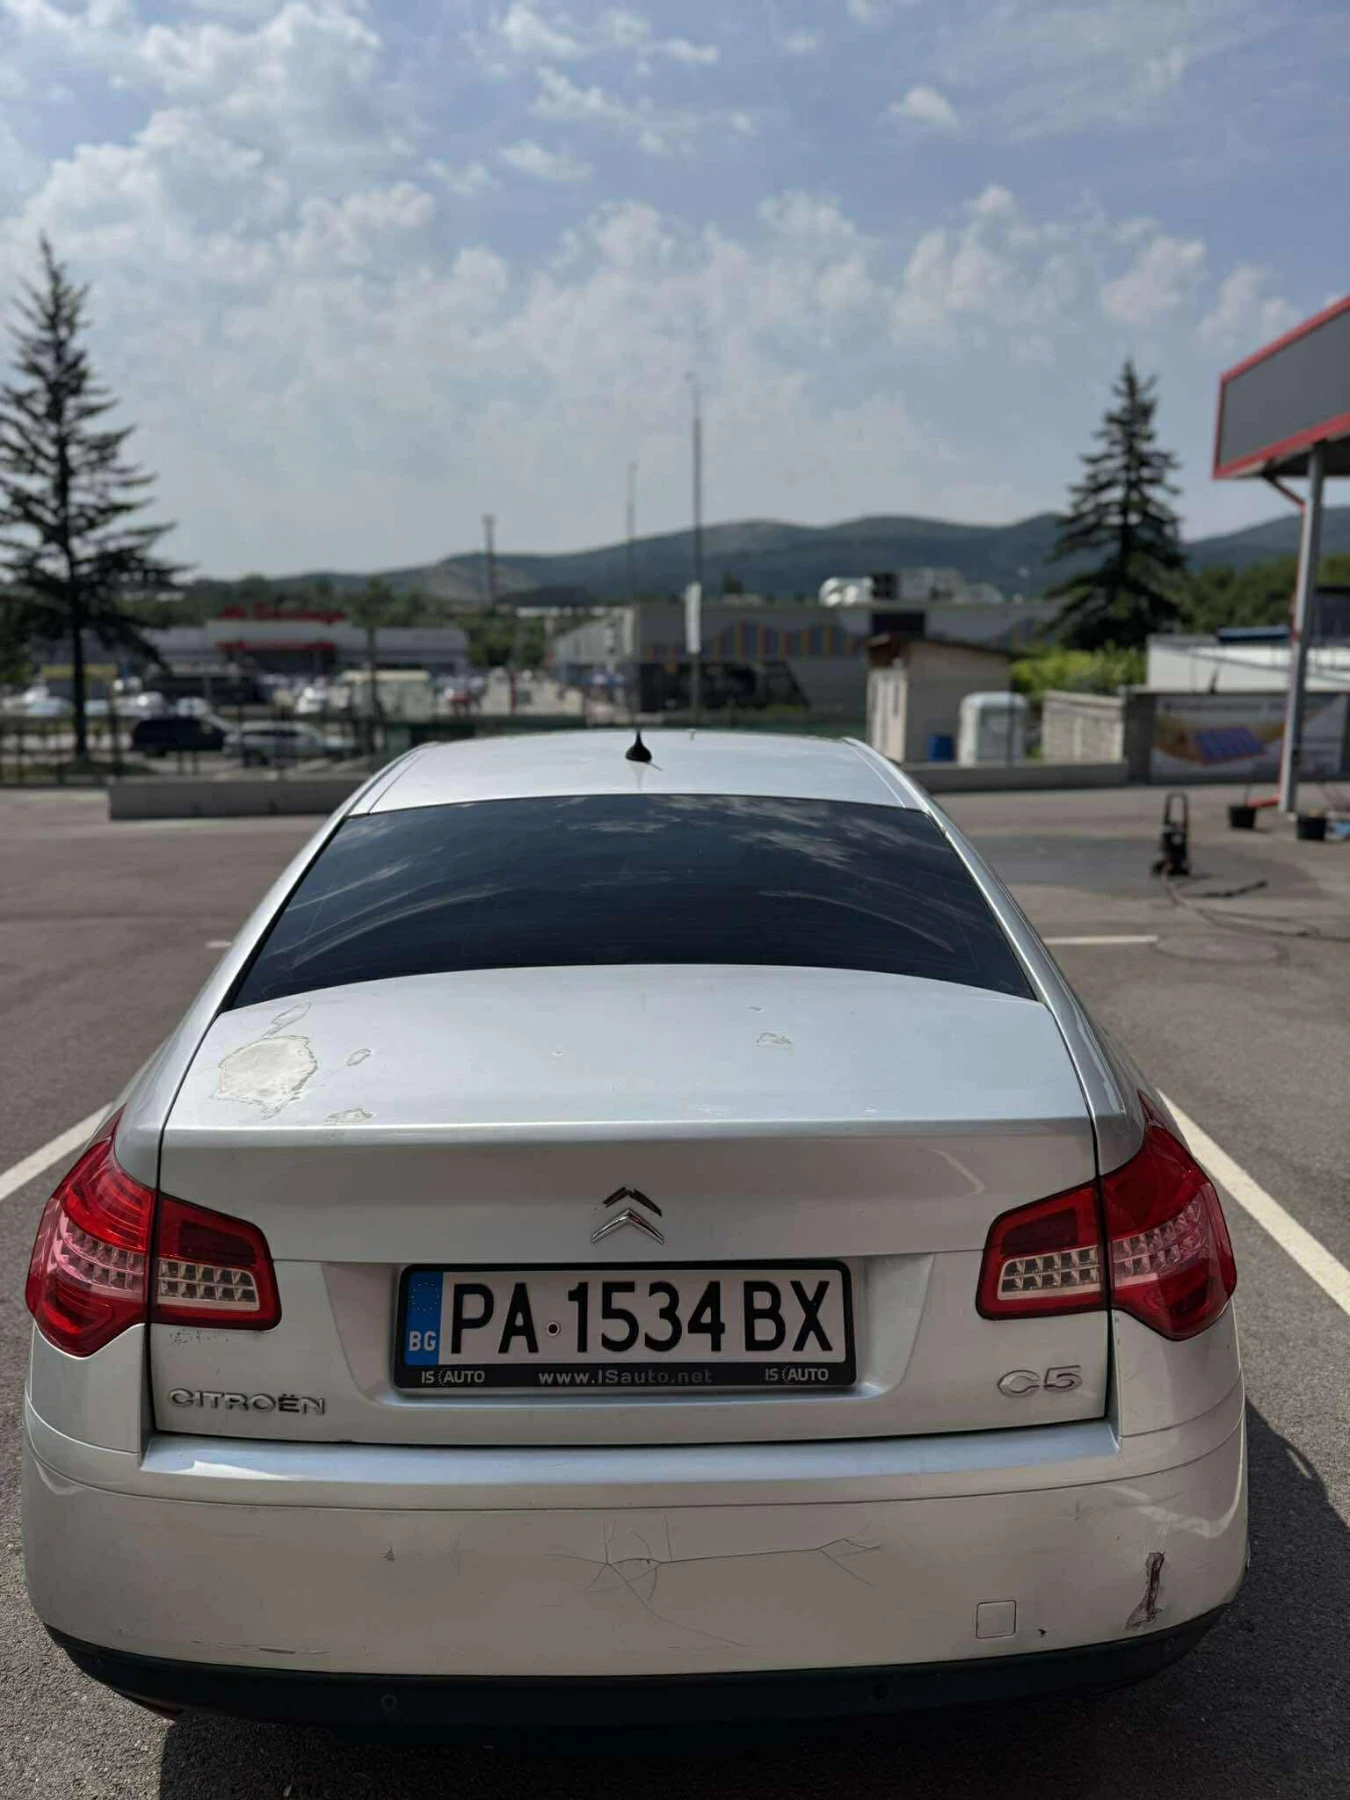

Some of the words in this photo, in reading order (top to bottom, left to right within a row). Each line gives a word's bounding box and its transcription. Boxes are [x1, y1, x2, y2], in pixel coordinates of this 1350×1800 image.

[451, 1282, 539, 1354] PA
[568, 1280, 726, 1353] 1534
[743, 1280, 834, 1352] BX
[408, 1330, 437, 1352] BG
[538, 1369, 713, 1385] www.ISauto.net
[997, 1365, 1083, 1398] C5
[168, 1388, 326, 1416] CITROËN
